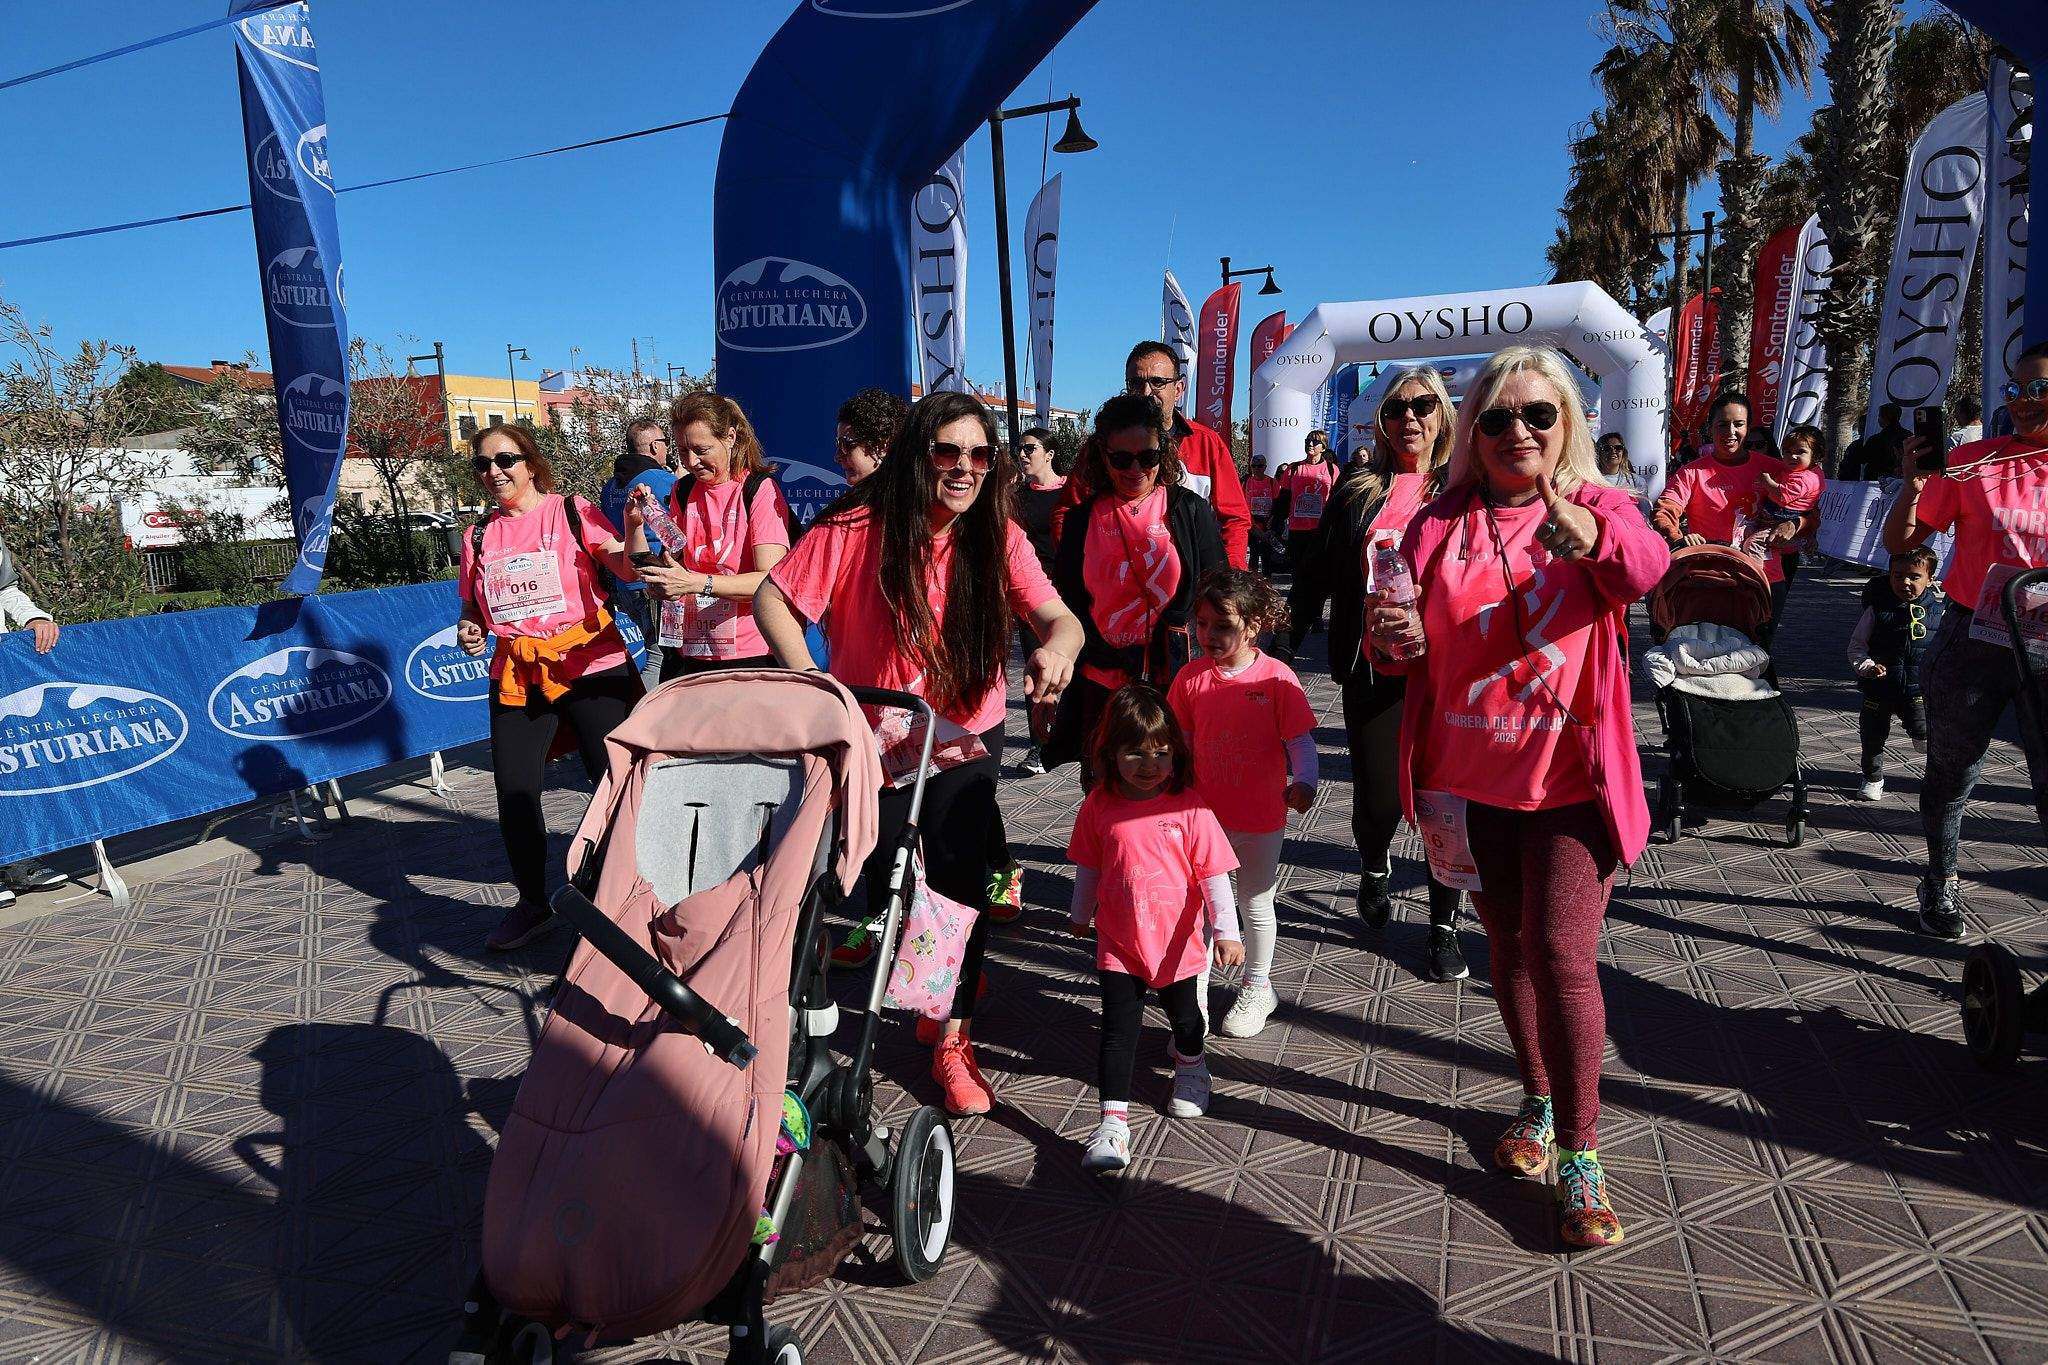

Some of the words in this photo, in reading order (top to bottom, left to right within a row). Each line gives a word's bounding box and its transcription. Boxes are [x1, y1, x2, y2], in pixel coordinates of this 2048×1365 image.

[272, 274, 331, 307] ASTURI
[915, 175, 960, 393] YSHO
[1886, 145, 1981, 408] OYSHO
[731, 289, 779, 302] CENTRAL
[785, 289, 847, 300] LECHERA
[1764, 254, 1796, 357] Santander
[719, 297, 854, 332] ASTURIANA
[1368, 302, 1533, 343] OYSHO
[1583, 329, 1635, 343] OYSHO
[1212, 311, 1228, 394] Santander
[1277, 354, 1322, 365] OYSHO
[288, 399, 344, 434] ASTURIA
[1611, 397, 1660, 410] OYSHO
[1257, 417, 1299, 428] OYSHO
[787, 489, 846, 498] LECHER
[1992, 507, 2048, 535] DOR
[510, 581, 538, 594] 016
[251, 677, 313, 694] CENTRAL
[315, 666, 370, 684] LECHERA
[420, 660, 489, 690] ASTUR
[82, 704, 158, 725] LECHERA
[229, 678, 383, 729] ASTURIANA
[1444, 711, 1490, 730] CARRERA
[1493, 716, 1509, 730] DE
[1512, 716, 1526, 730] LA
[1530, 716, 1566, 731] MUJE
[0, 717, 176, 776] STURIANA
[1494, 732, 1517, 743] 2025
